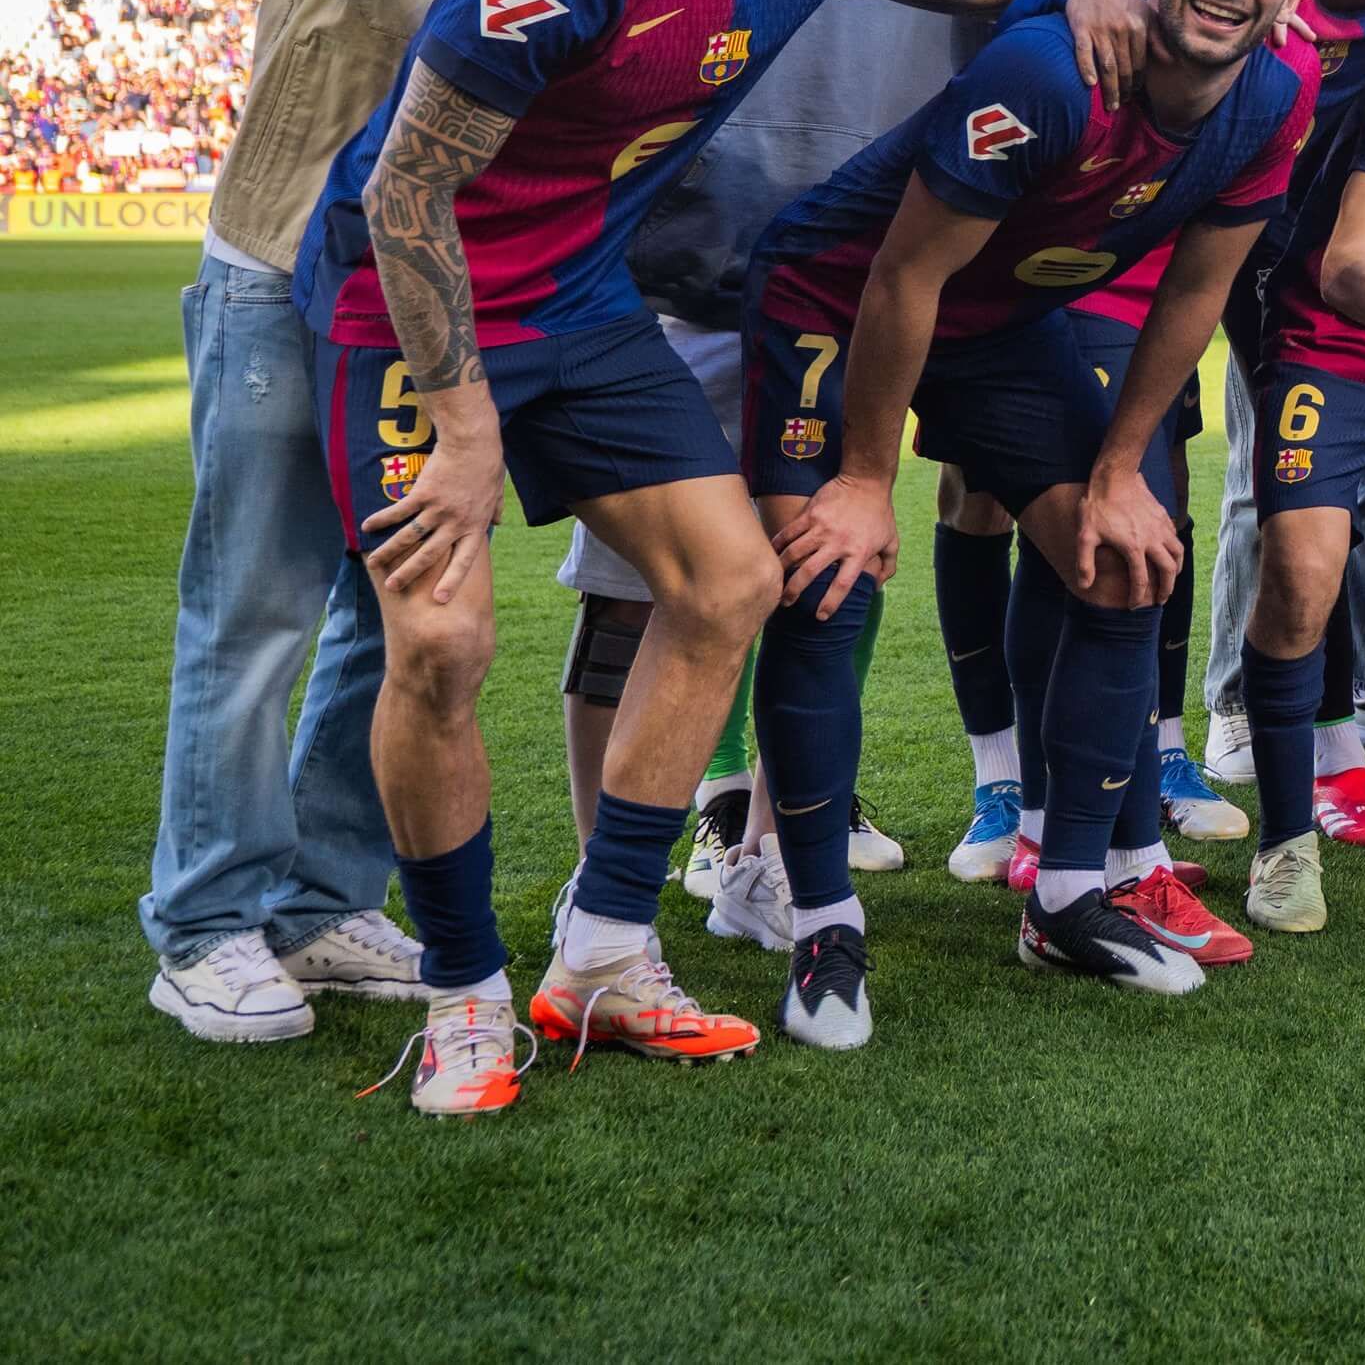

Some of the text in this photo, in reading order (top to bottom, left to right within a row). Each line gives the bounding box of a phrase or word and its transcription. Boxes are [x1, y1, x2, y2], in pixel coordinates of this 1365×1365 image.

[28, 200, 206, 228] UNLOCK
[378, 361, 433, 448] 5
[795, 333, 840, 409] 7
[1278, 383, 1326, 442] 6
